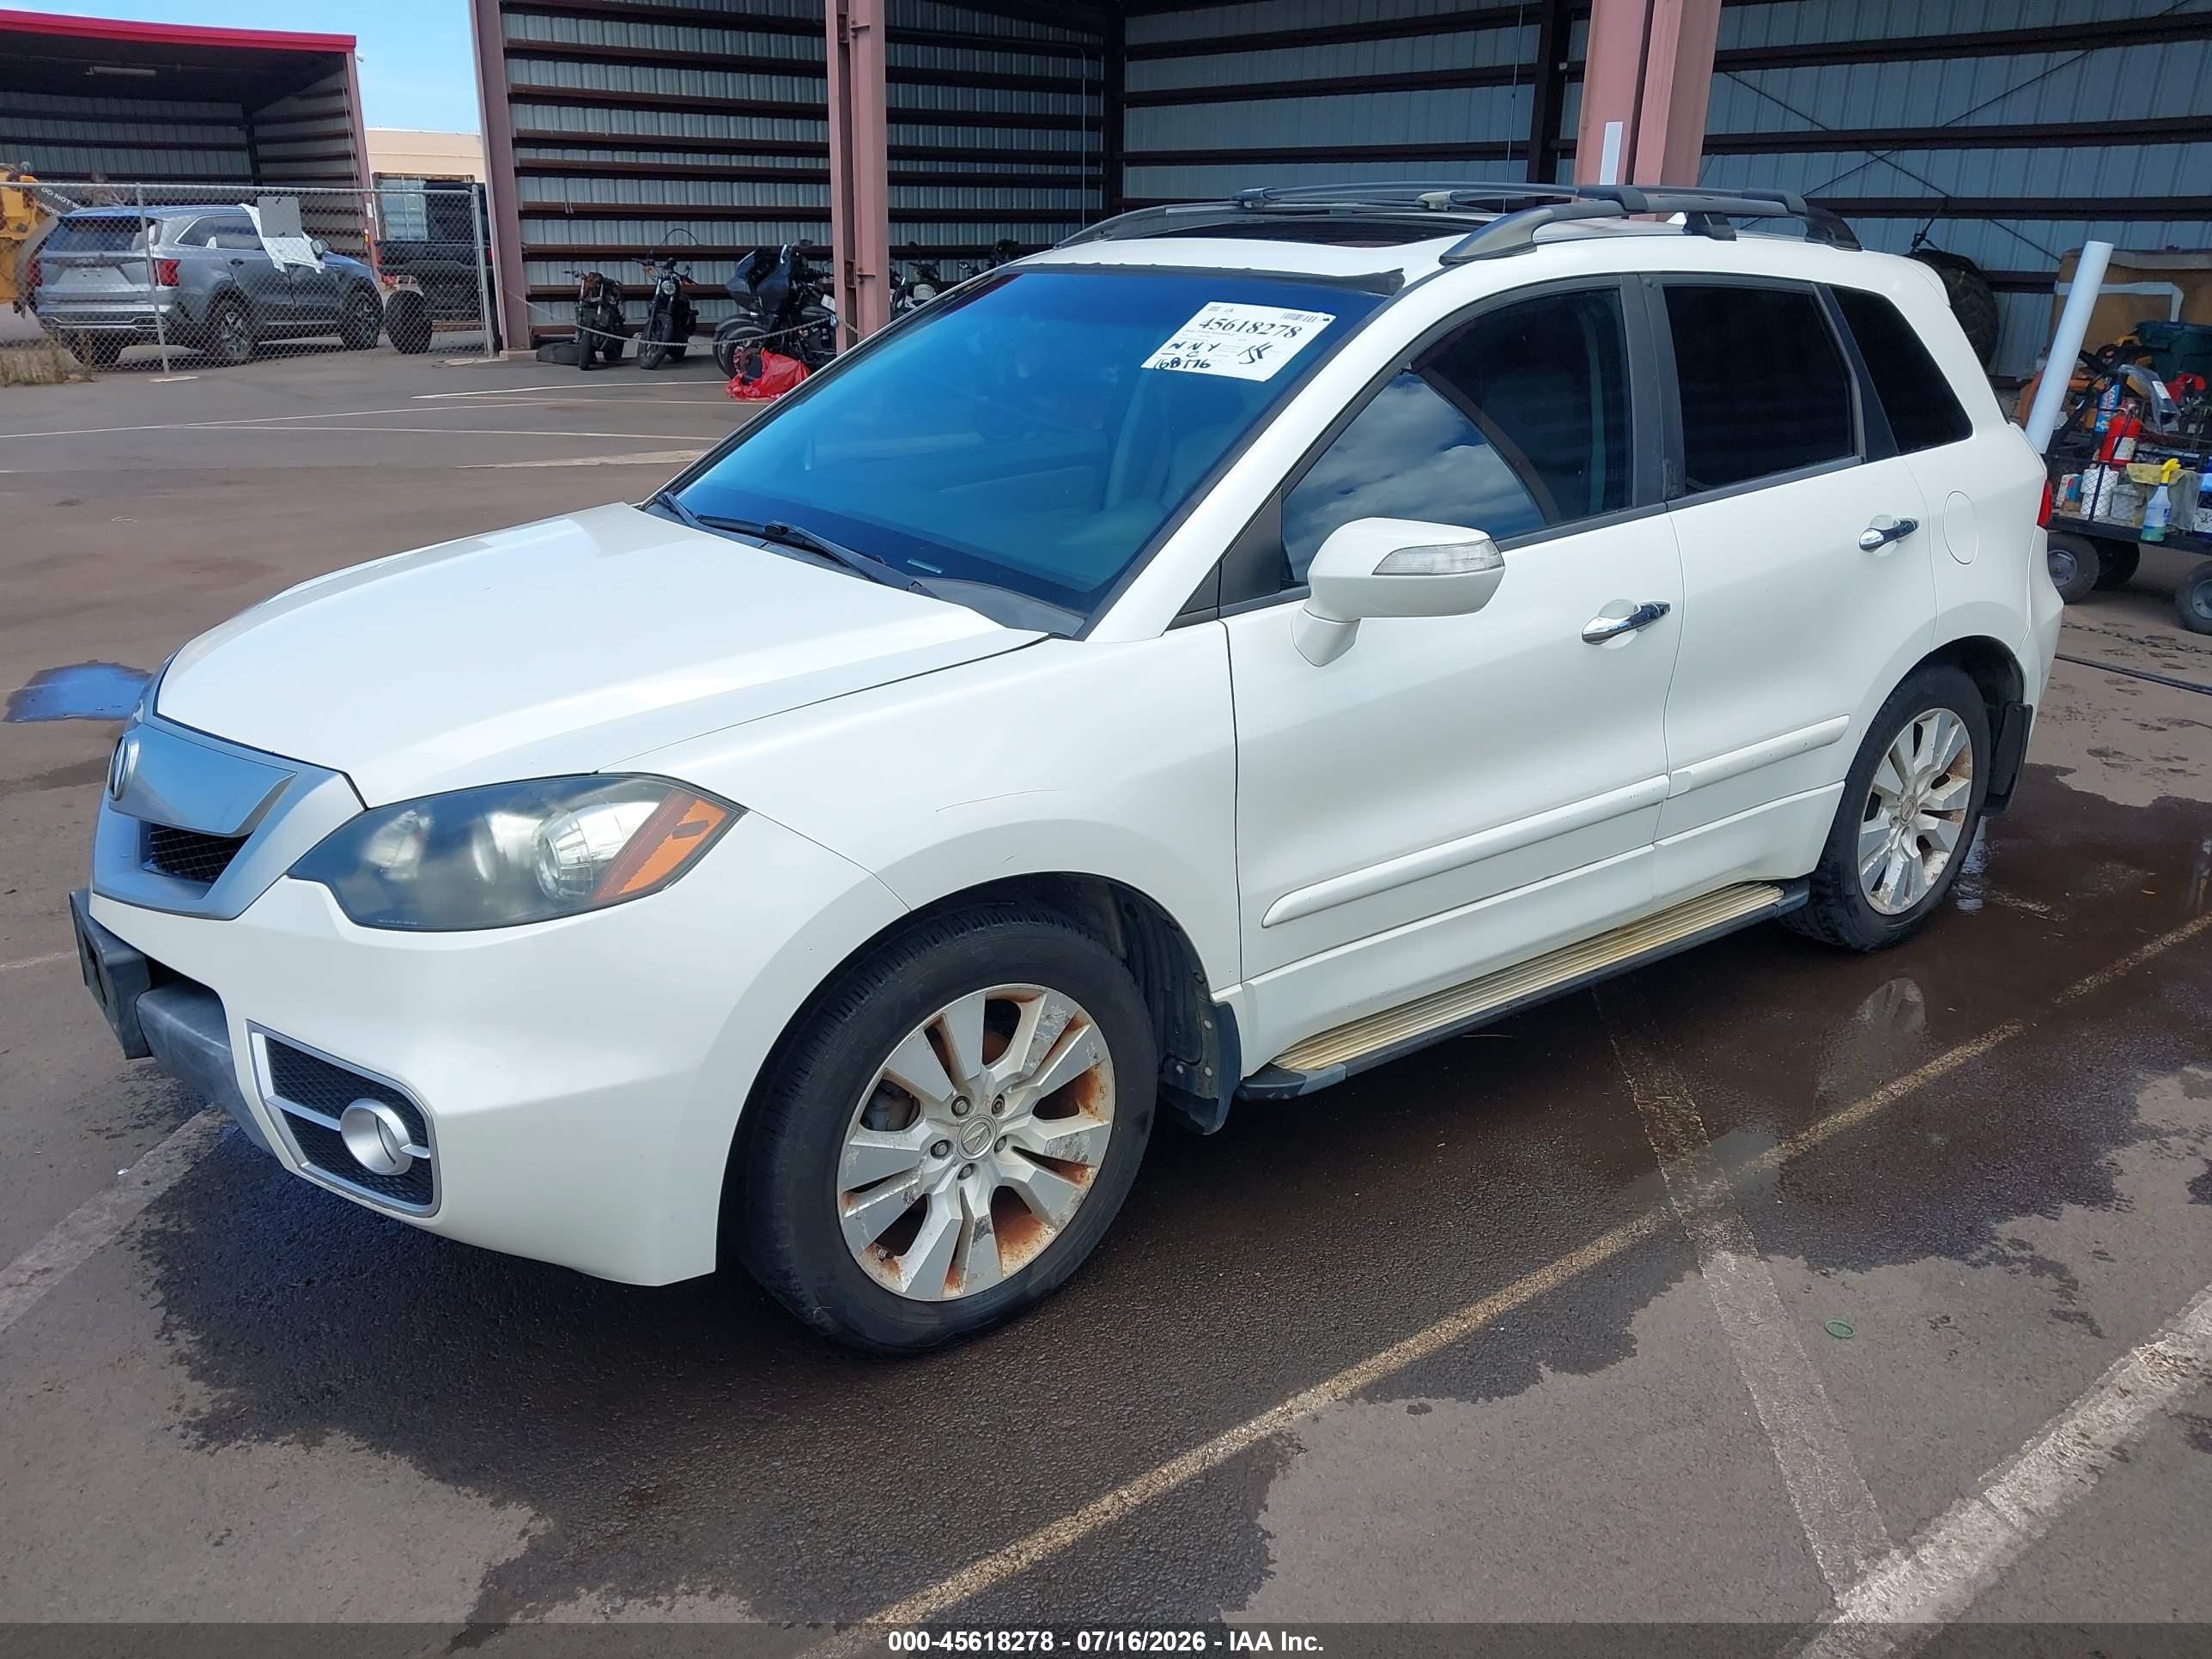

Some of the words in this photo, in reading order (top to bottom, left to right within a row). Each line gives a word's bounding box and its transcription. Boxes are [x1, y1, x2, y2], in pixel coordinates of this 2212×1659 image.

[41, 187, 53, 196] DO
[54, 193, 70, 205] NOT
[1199, 317, 1303, 338] 45618278
